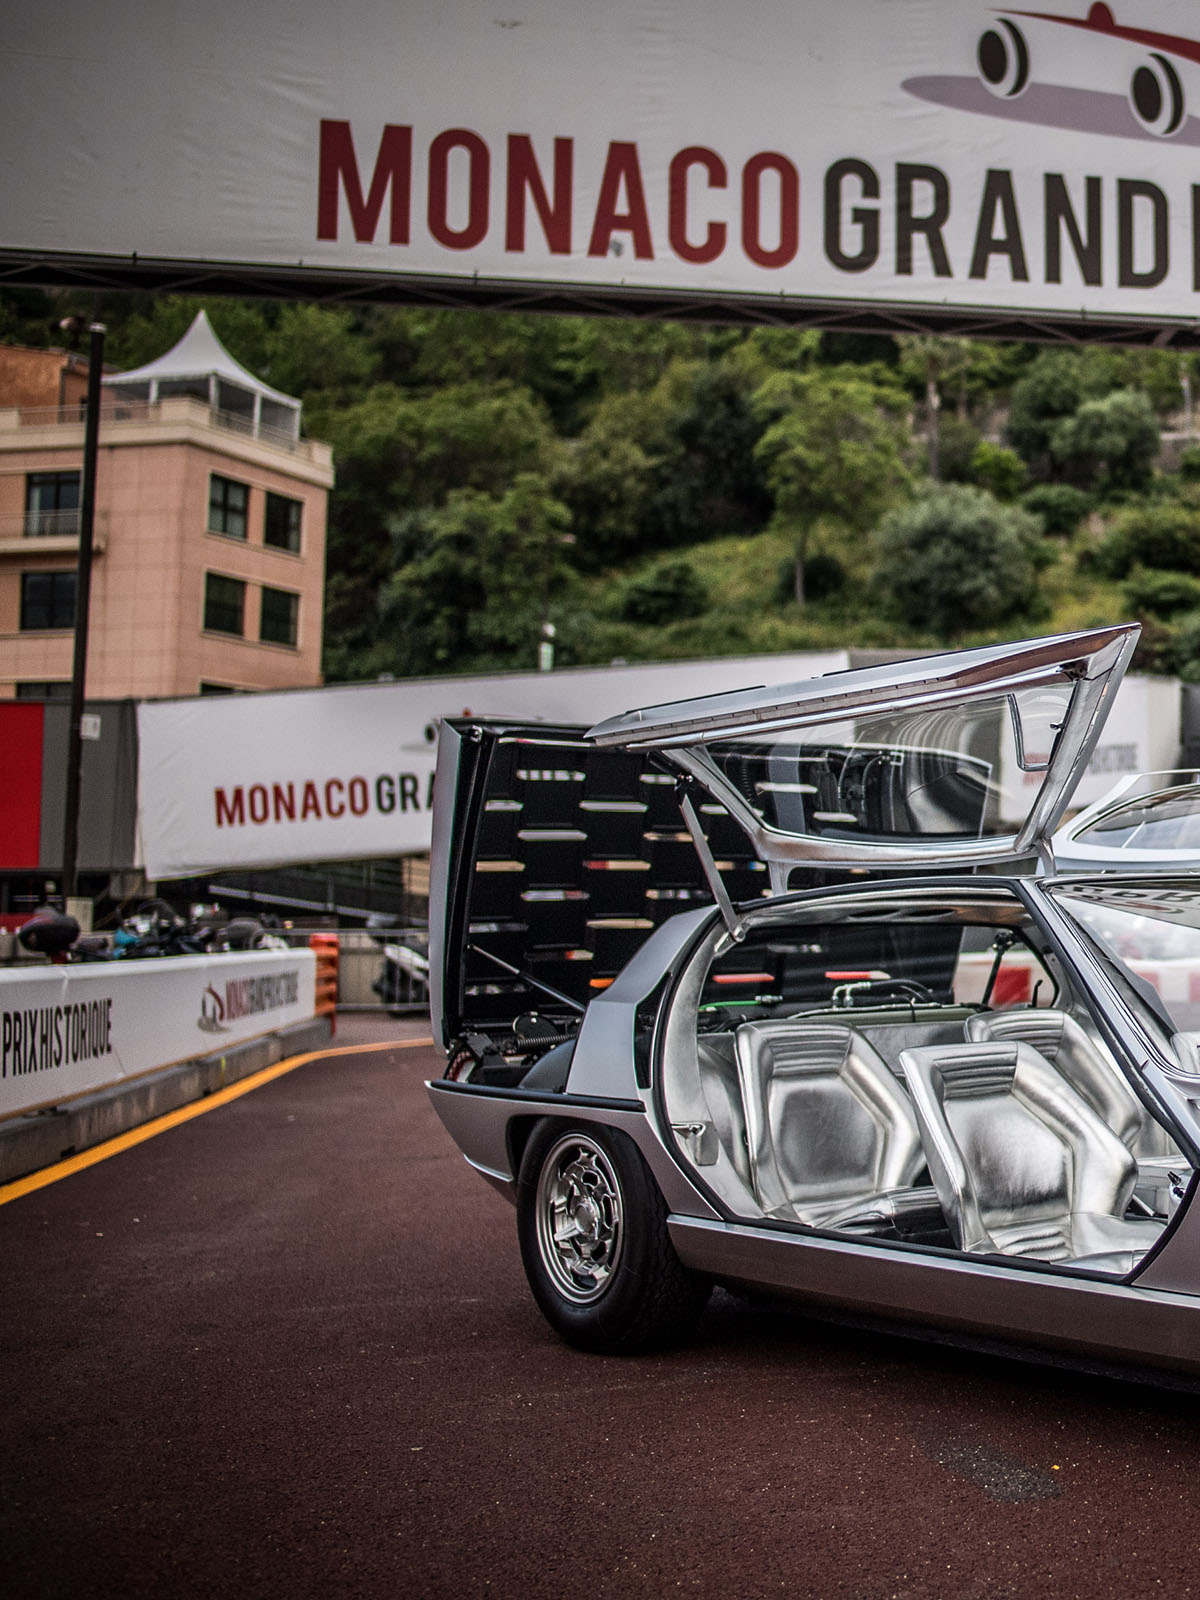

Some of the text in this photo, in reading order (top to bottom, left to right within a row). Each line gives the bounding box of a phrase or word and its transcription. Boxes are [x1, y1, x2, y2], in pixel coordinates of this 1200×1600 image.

[317, 118, 799, 270] MONACO
[823, 158, 1170, 290] GRAND
[215, 775, 370, 828] MONACO
[2, 997, 113, 1079] PRIX HISTORIQUE
